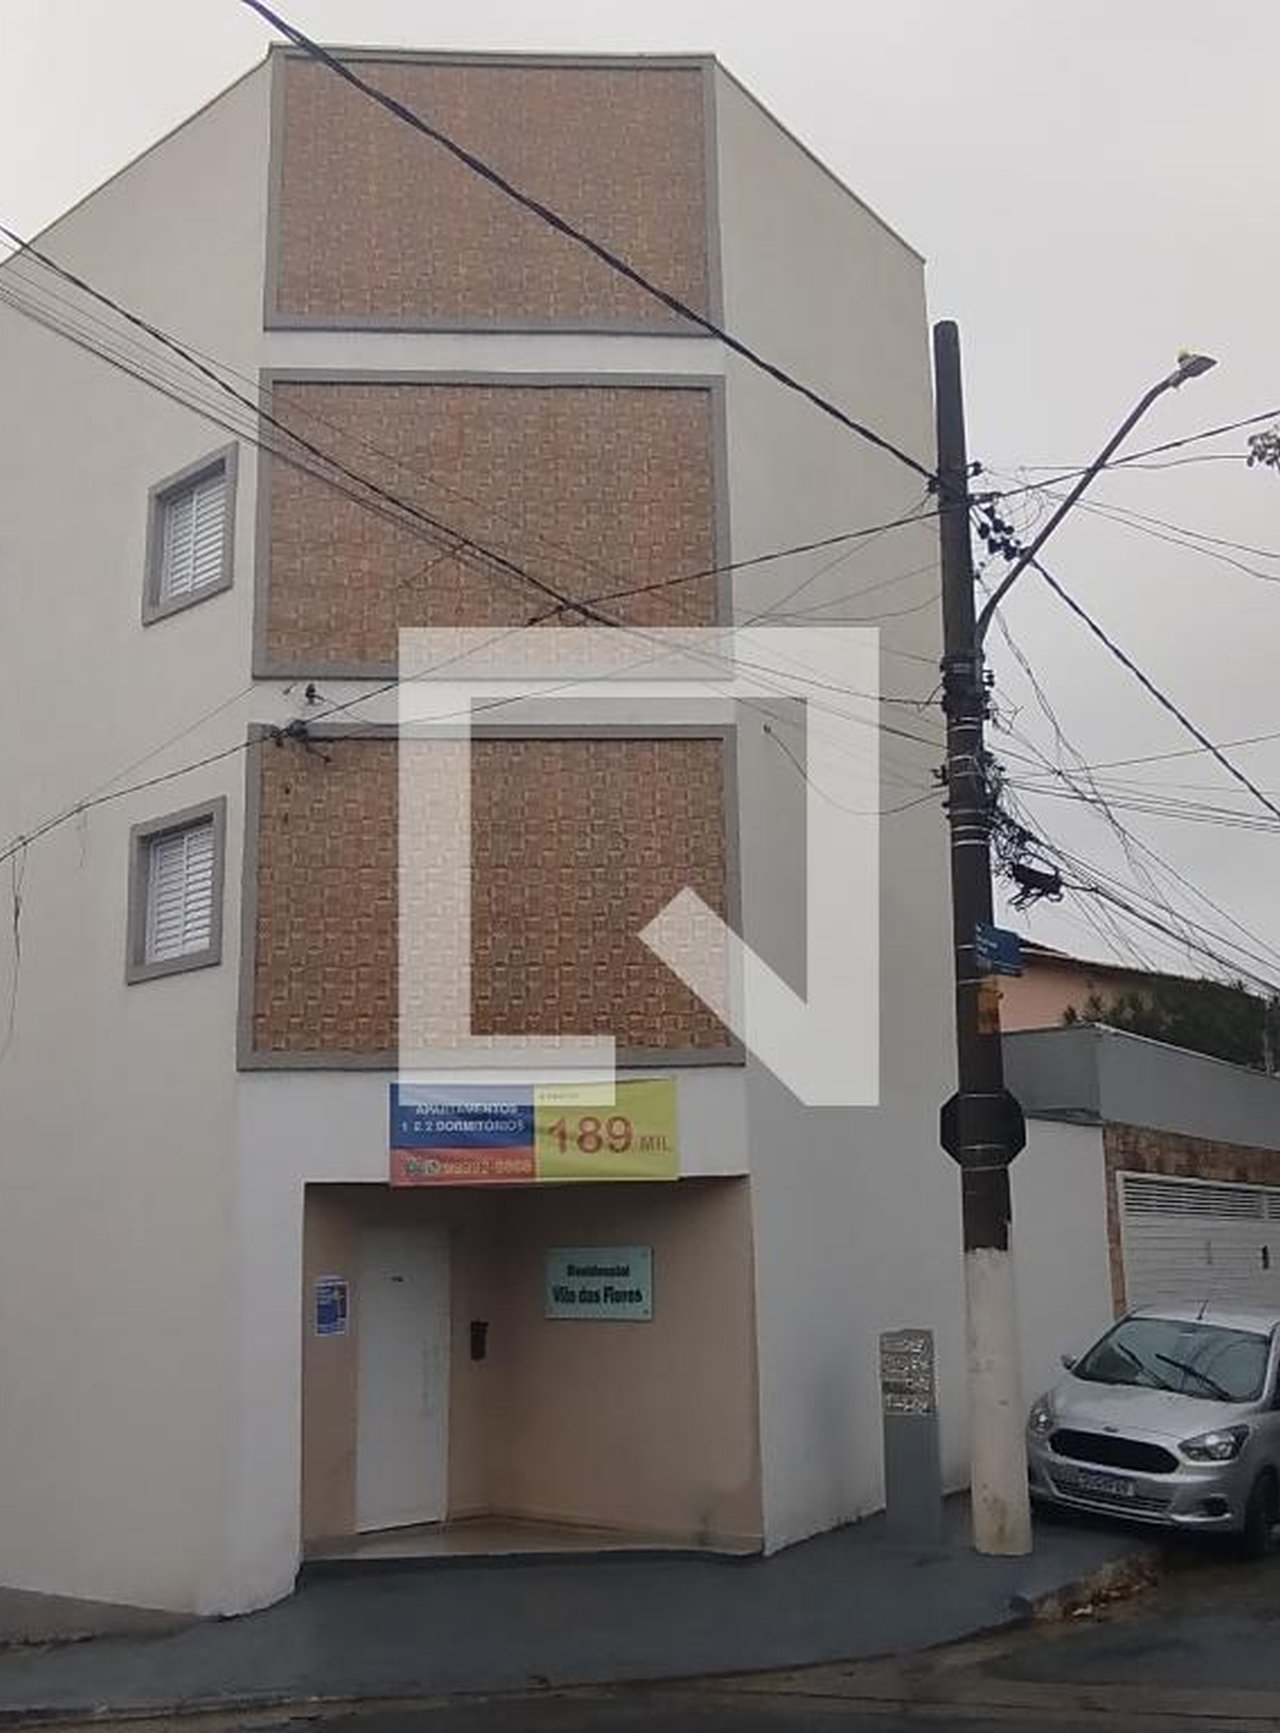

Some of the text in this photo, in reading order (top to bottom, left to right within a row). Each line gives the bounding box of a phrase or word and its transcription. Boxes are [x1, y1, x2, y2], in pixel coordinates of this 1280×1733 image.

[549, 1115, 670, 1154] 189 MIL
[579, 1286, 601, 1303] das
[603, 1286, 644, 1304] Flores
